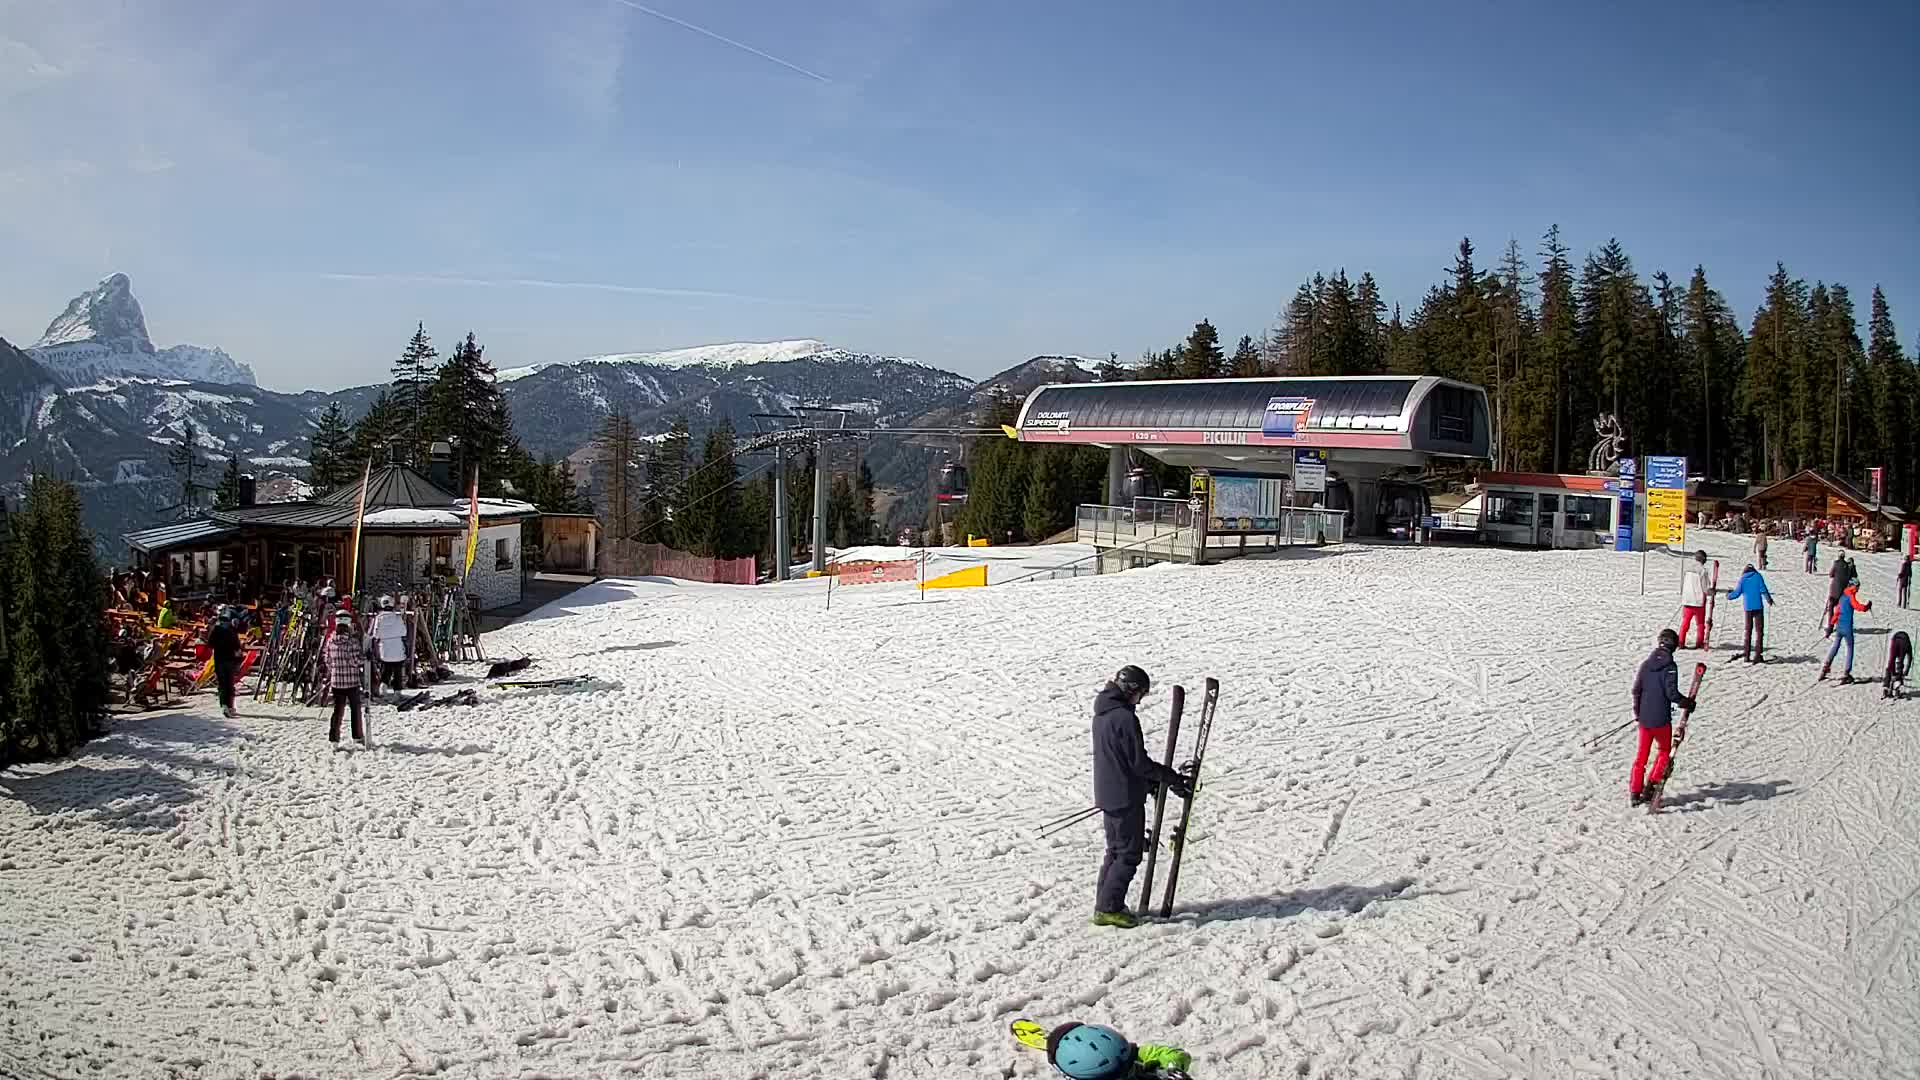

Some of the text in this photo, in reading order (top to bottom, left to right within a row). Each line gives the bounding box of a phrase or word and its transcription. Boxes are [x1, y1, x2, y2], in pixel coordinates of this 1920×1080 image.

[1037, 411, 1069, 419] DOLOMITI
[1131, 432, 1149, 440] 1620
[1203, 432, 1246, 444] PICULIN
